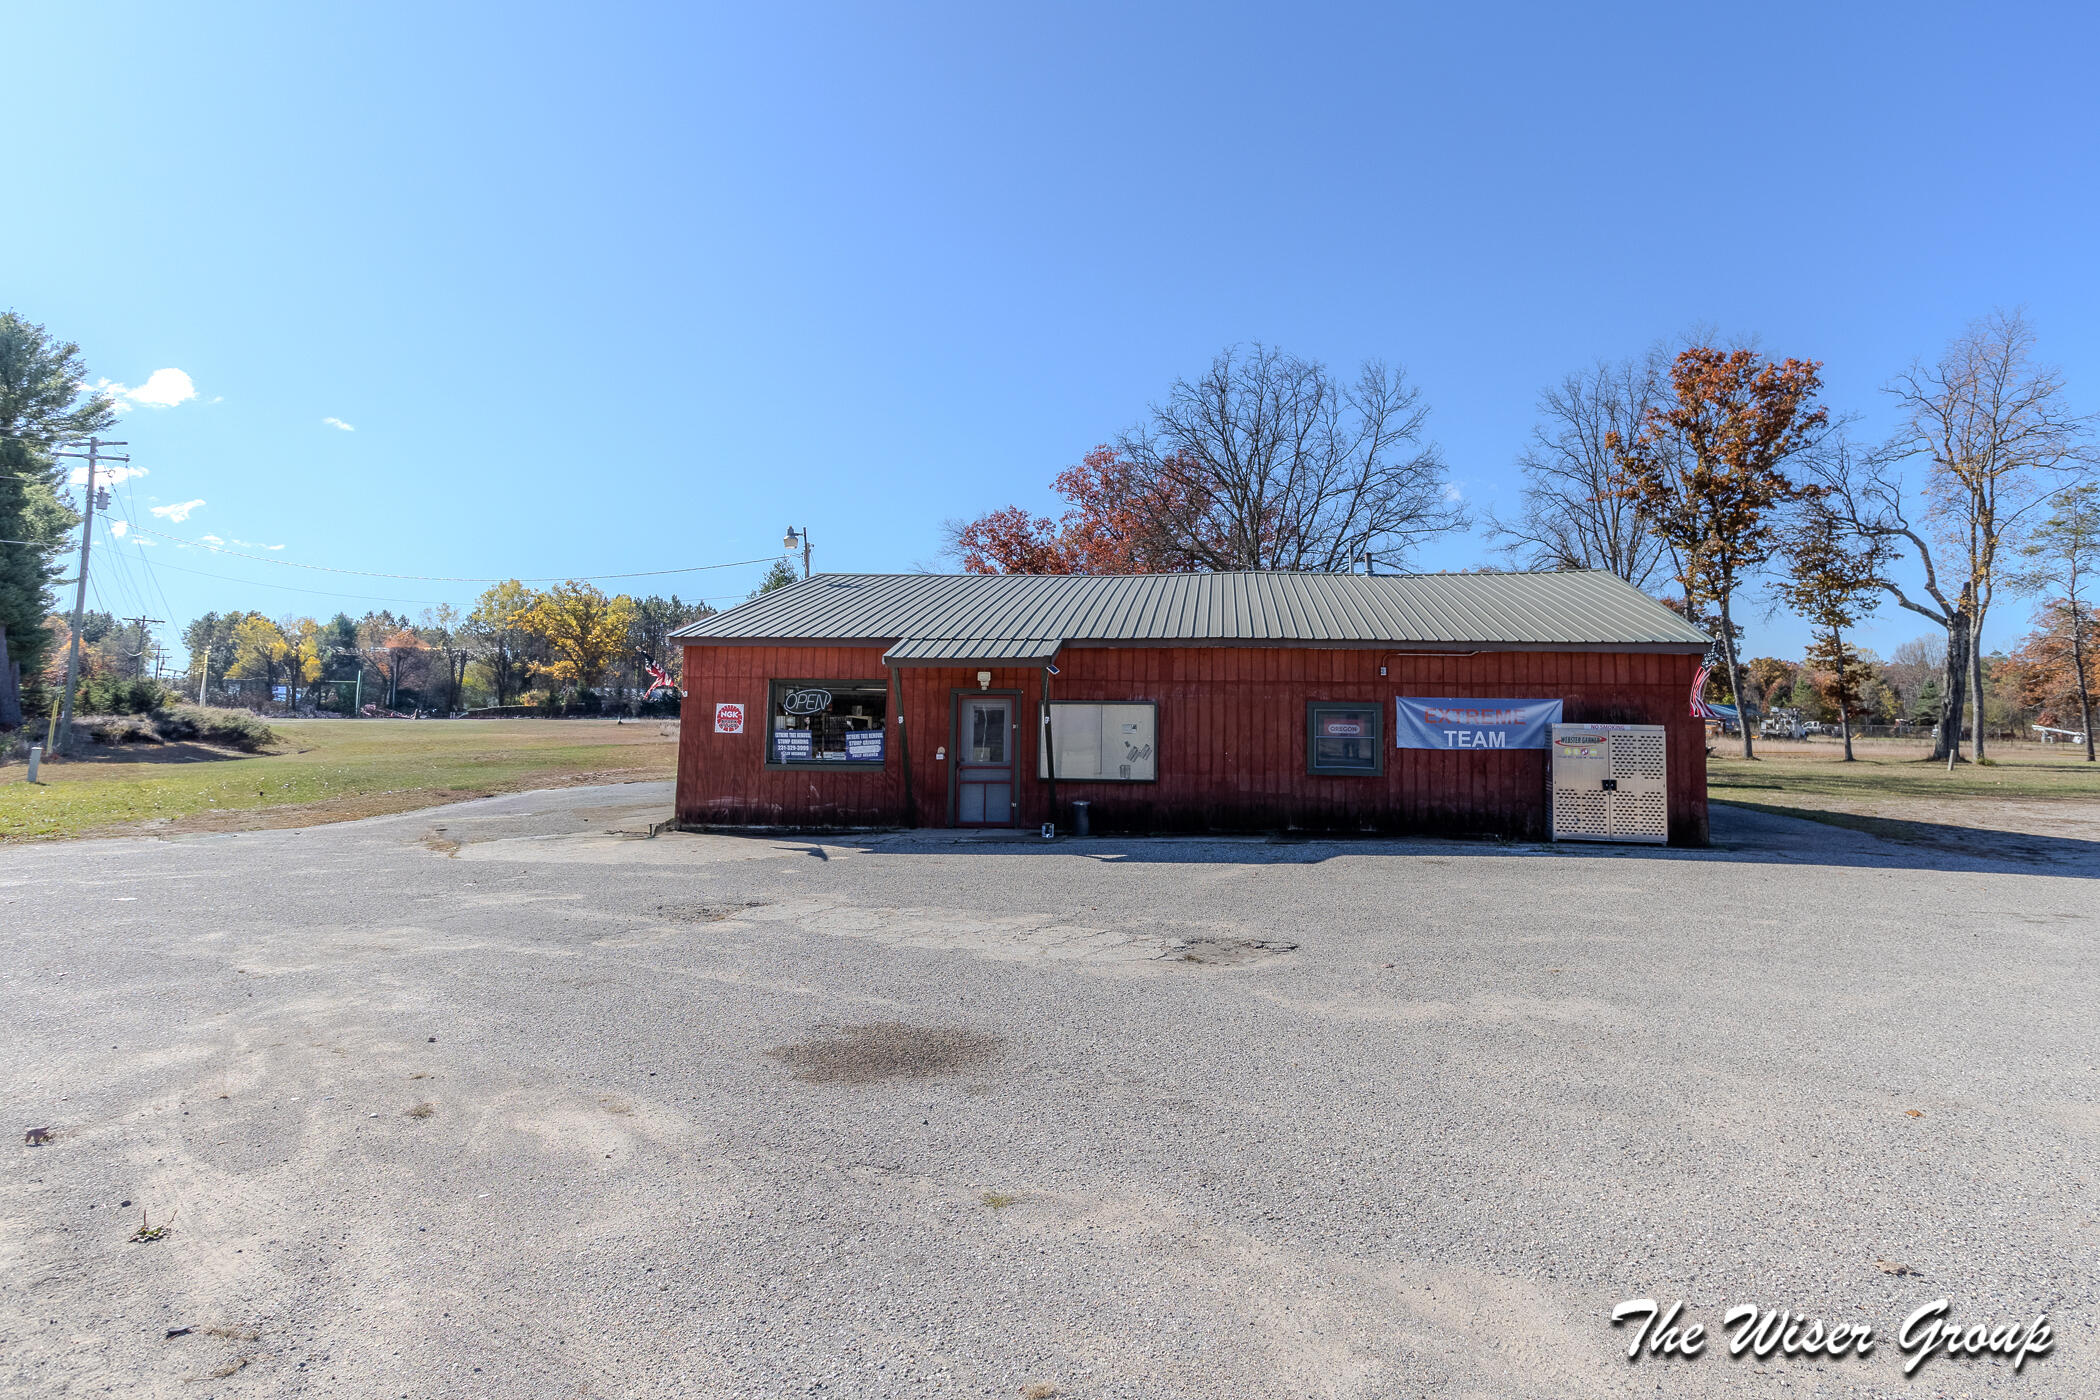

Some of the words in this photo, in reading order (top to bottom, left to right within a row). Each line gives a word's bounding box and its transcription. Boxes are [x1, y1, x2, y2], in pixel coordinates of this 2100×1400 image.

[786, 694, 827, 709] OPEN
[1424, 708, 1526, 725] EXTREME
[1444, 730, 1506, 748] TEAM
